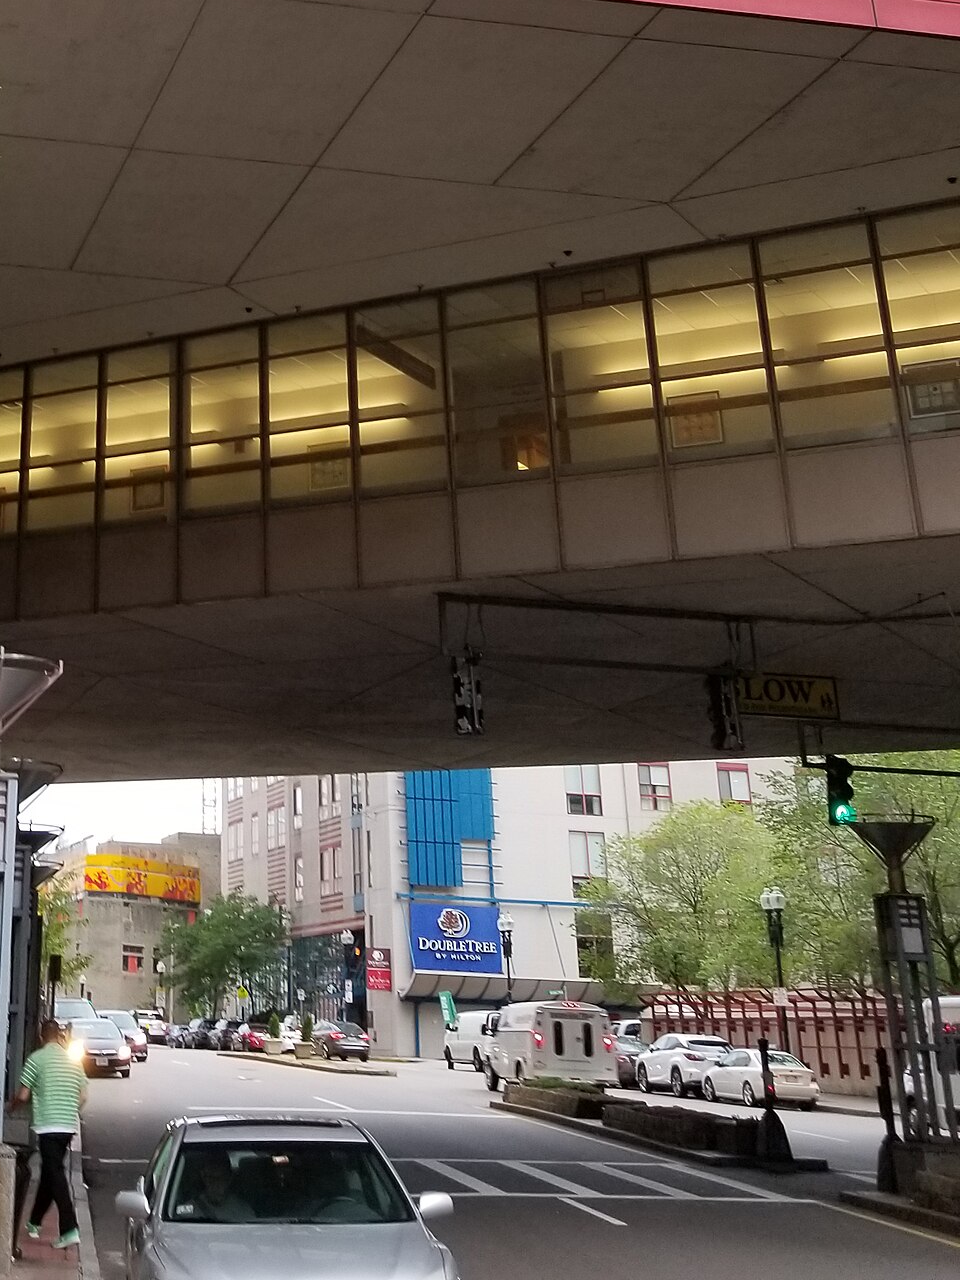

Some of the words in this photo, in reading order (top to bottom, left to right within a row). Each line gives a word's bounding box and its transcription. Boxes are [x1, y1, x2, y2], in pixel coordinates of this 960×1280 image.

[418, 936, 498, 954] DOUBLETREE
[435, 952, 447, 960] BY
[450, 953, 482, 962] HILTON
